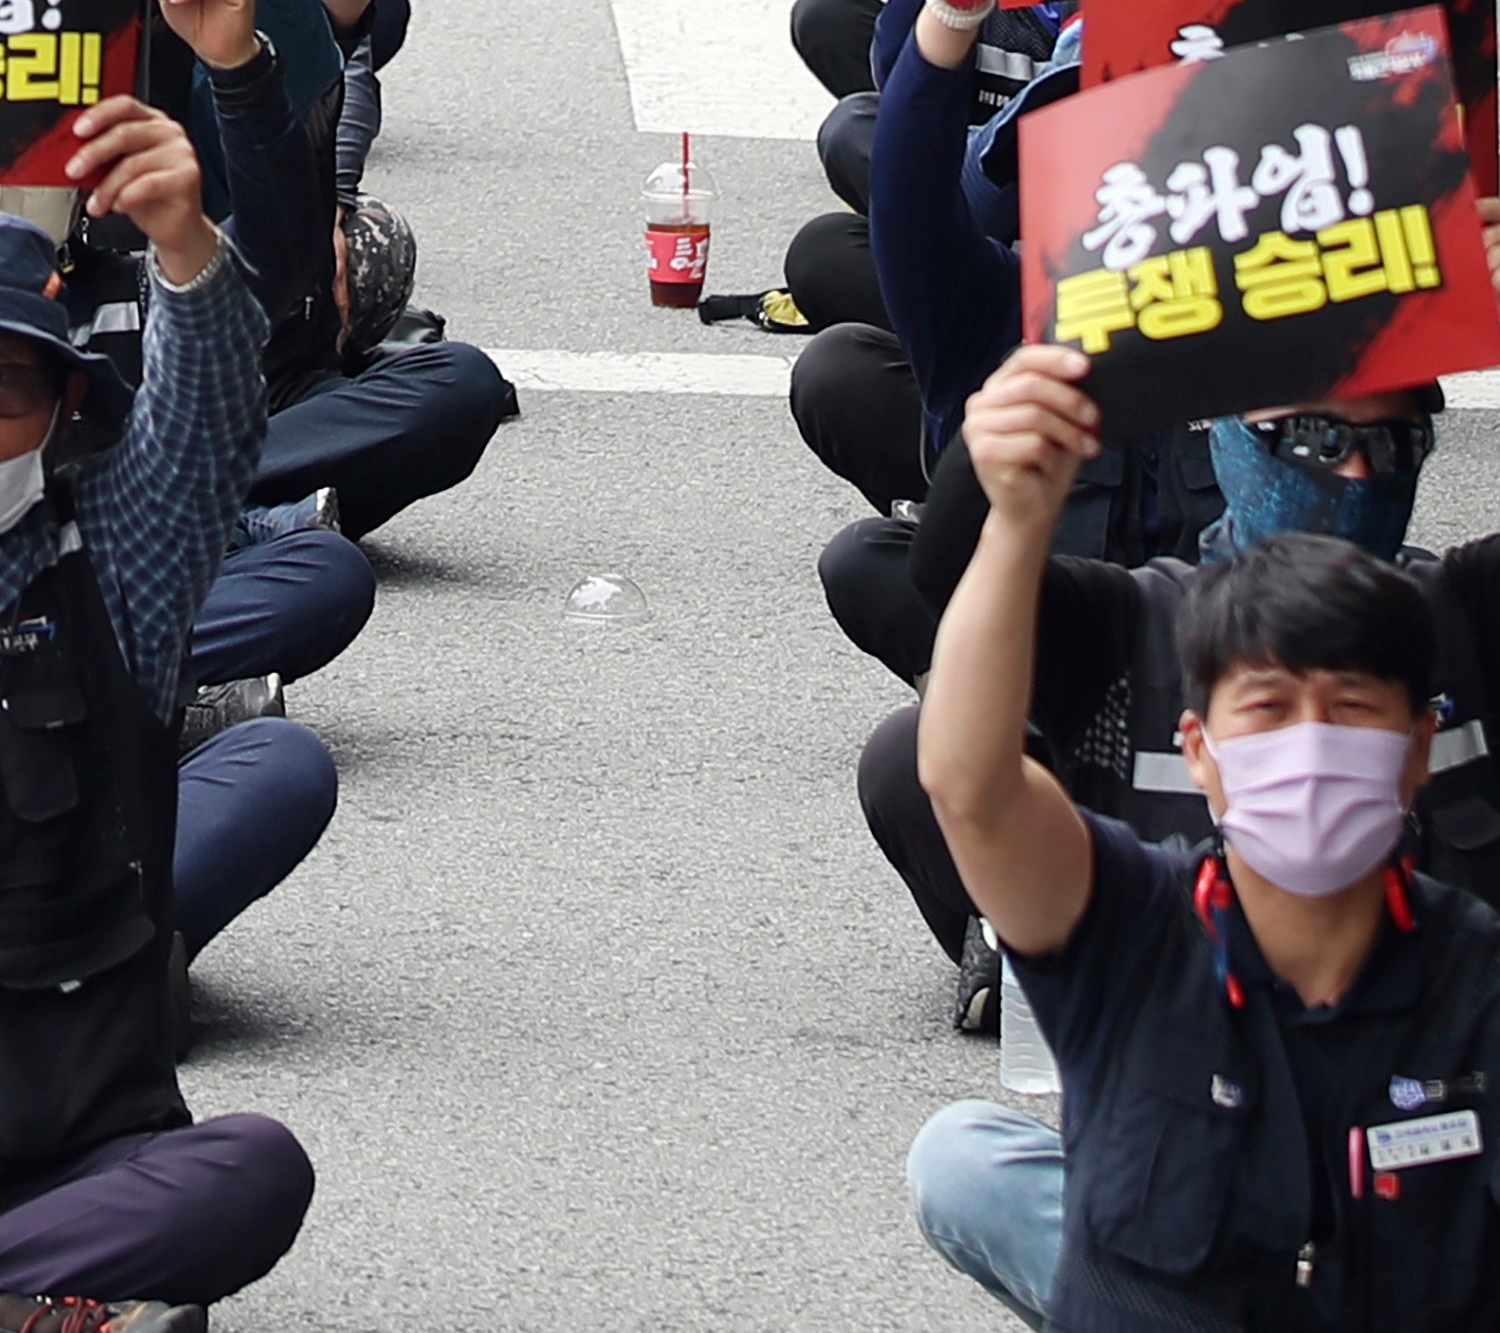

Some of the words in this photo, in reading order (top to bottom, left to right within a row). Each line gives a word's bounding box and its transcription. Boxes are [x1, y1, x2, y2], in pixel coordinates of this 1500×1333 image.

[1078, 125, 1372, 275] 총파업!
[1059, 246, 1222, 352] 투쟁
[1234, 205, 1439, 319] 승리!
